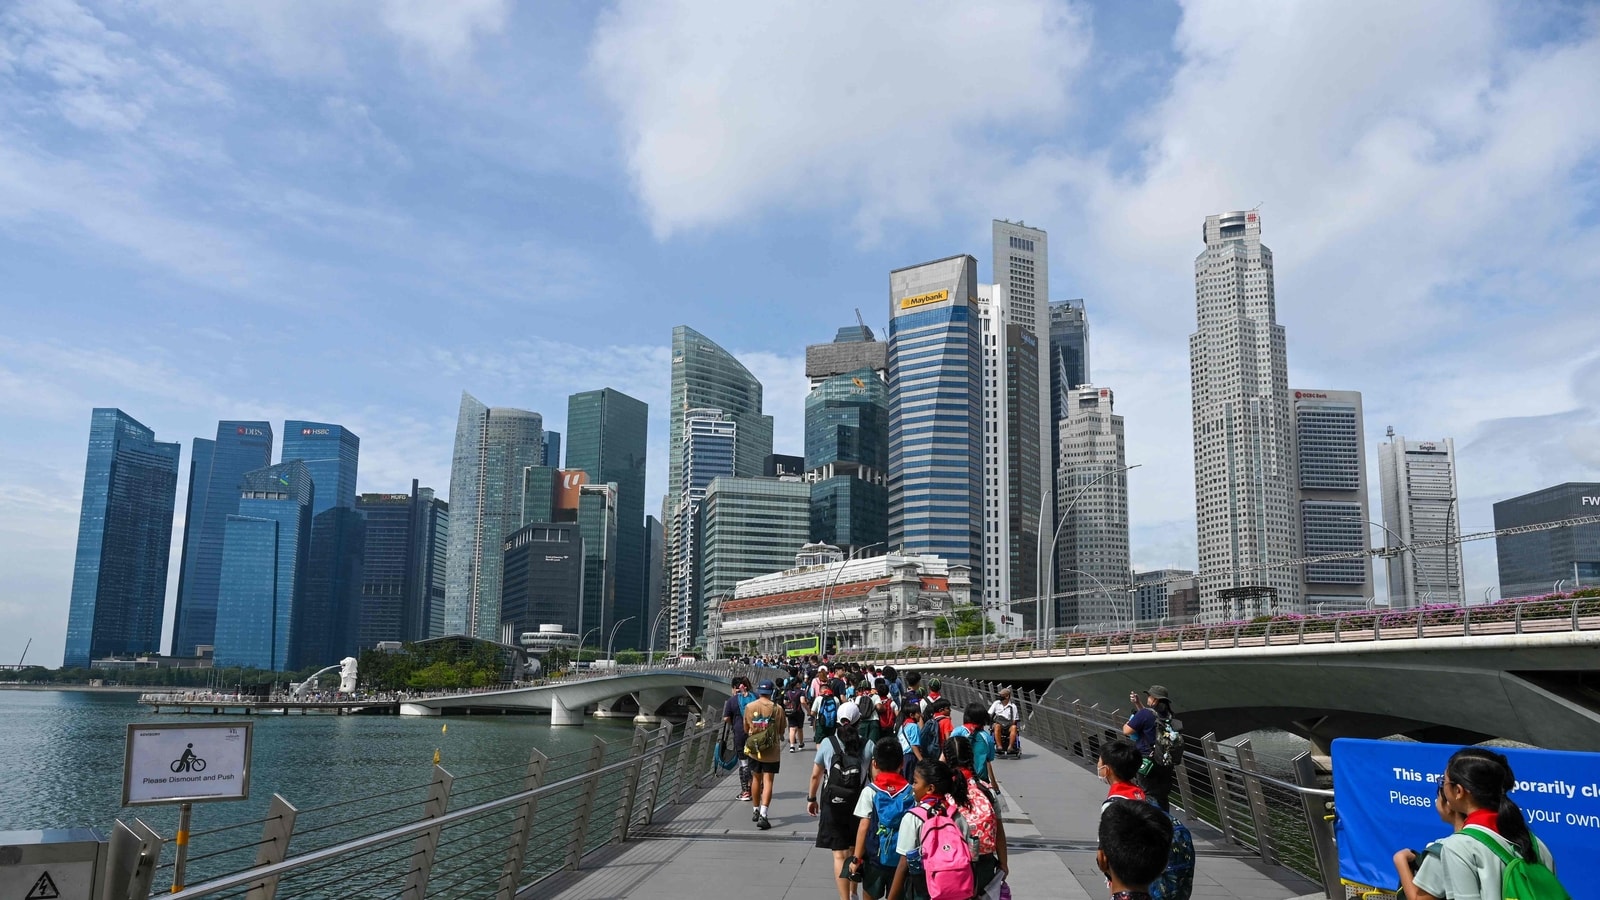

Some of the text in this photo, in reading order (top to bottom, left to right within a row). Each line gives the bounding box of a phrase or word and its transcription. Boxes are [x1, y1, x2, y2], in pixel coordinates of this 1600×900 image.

[910, 292, 943, 305] Maybank
[245, 428, 262, 436] DBS
[169, 775, 202, 783] Dismount
[1393, 767, 1600, 799] This ar porarily cl
[1390, 790, 1600, 828] Please your own
